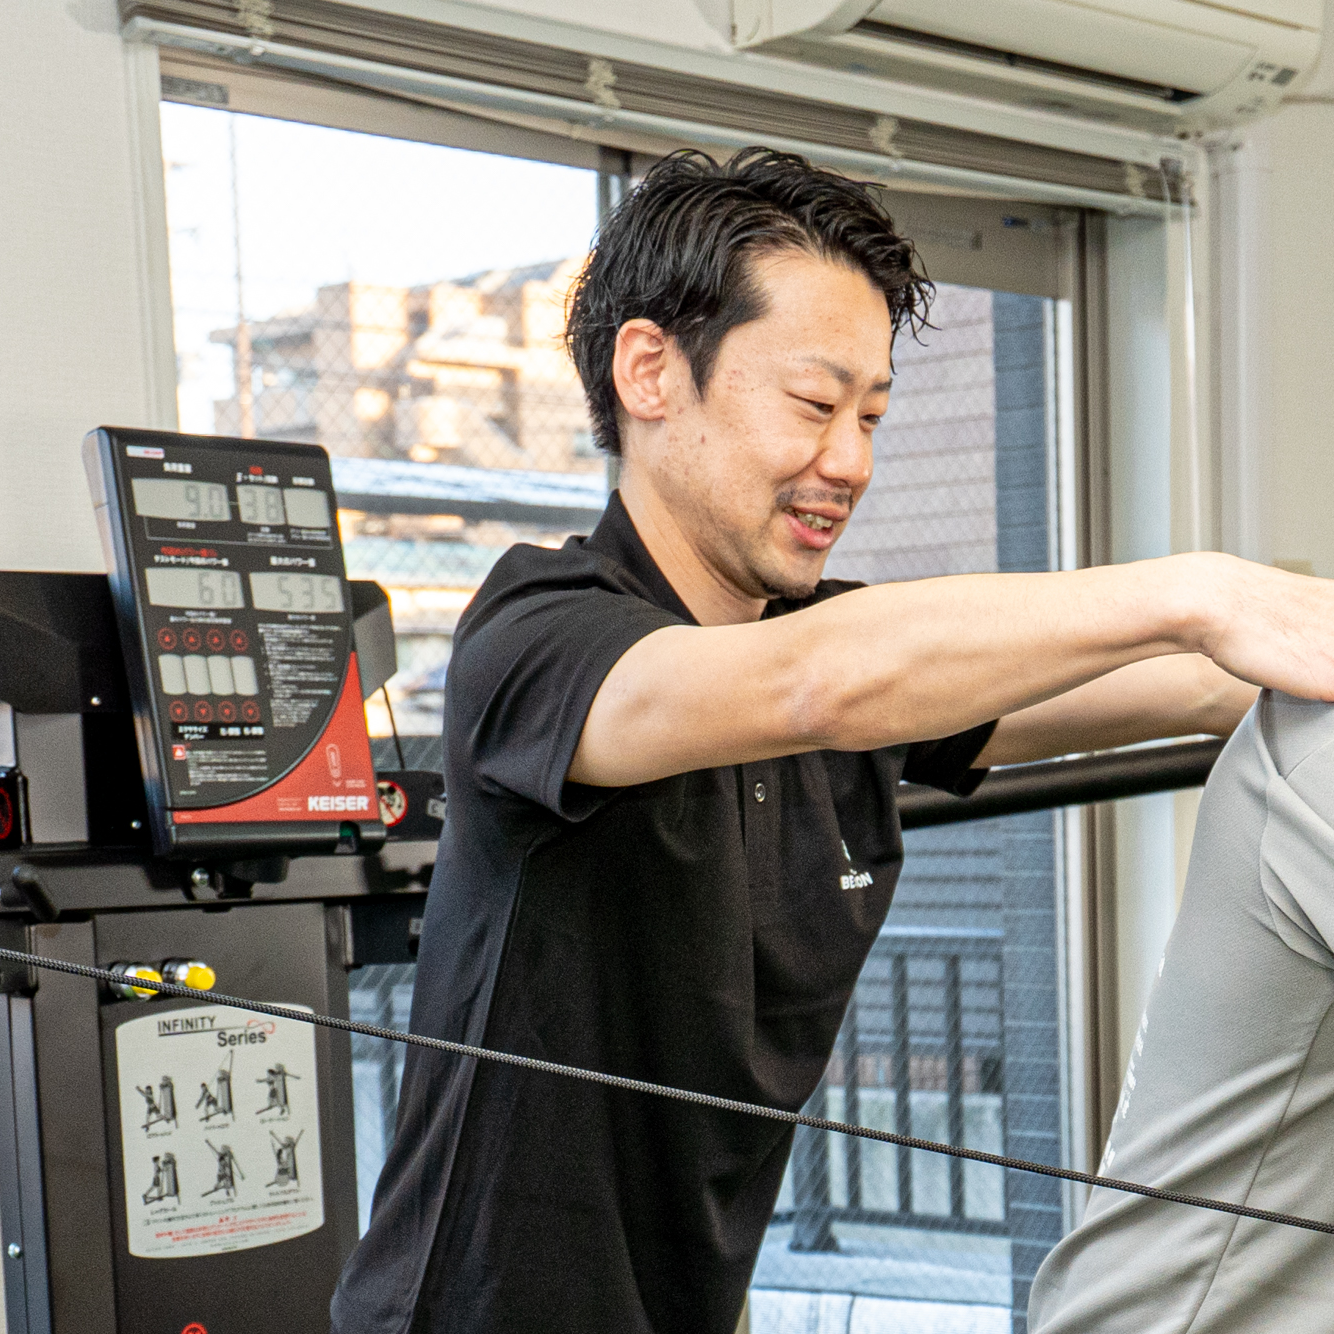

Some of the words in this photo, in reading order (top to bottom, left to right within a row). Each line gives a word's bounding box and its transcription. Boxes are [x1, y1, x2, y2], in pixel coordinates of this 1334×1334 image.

[185, 484, 223, 518] 9.0
[243, 487, 280, 522] 38
[198, 572, 236, 606] 60
[277, 575, 336, 609] 535
[307, 795, 369, 811] KEISER
[157, 1015, 216, 1034] INFINITY
[217, 1028, 267, 1047] Series
